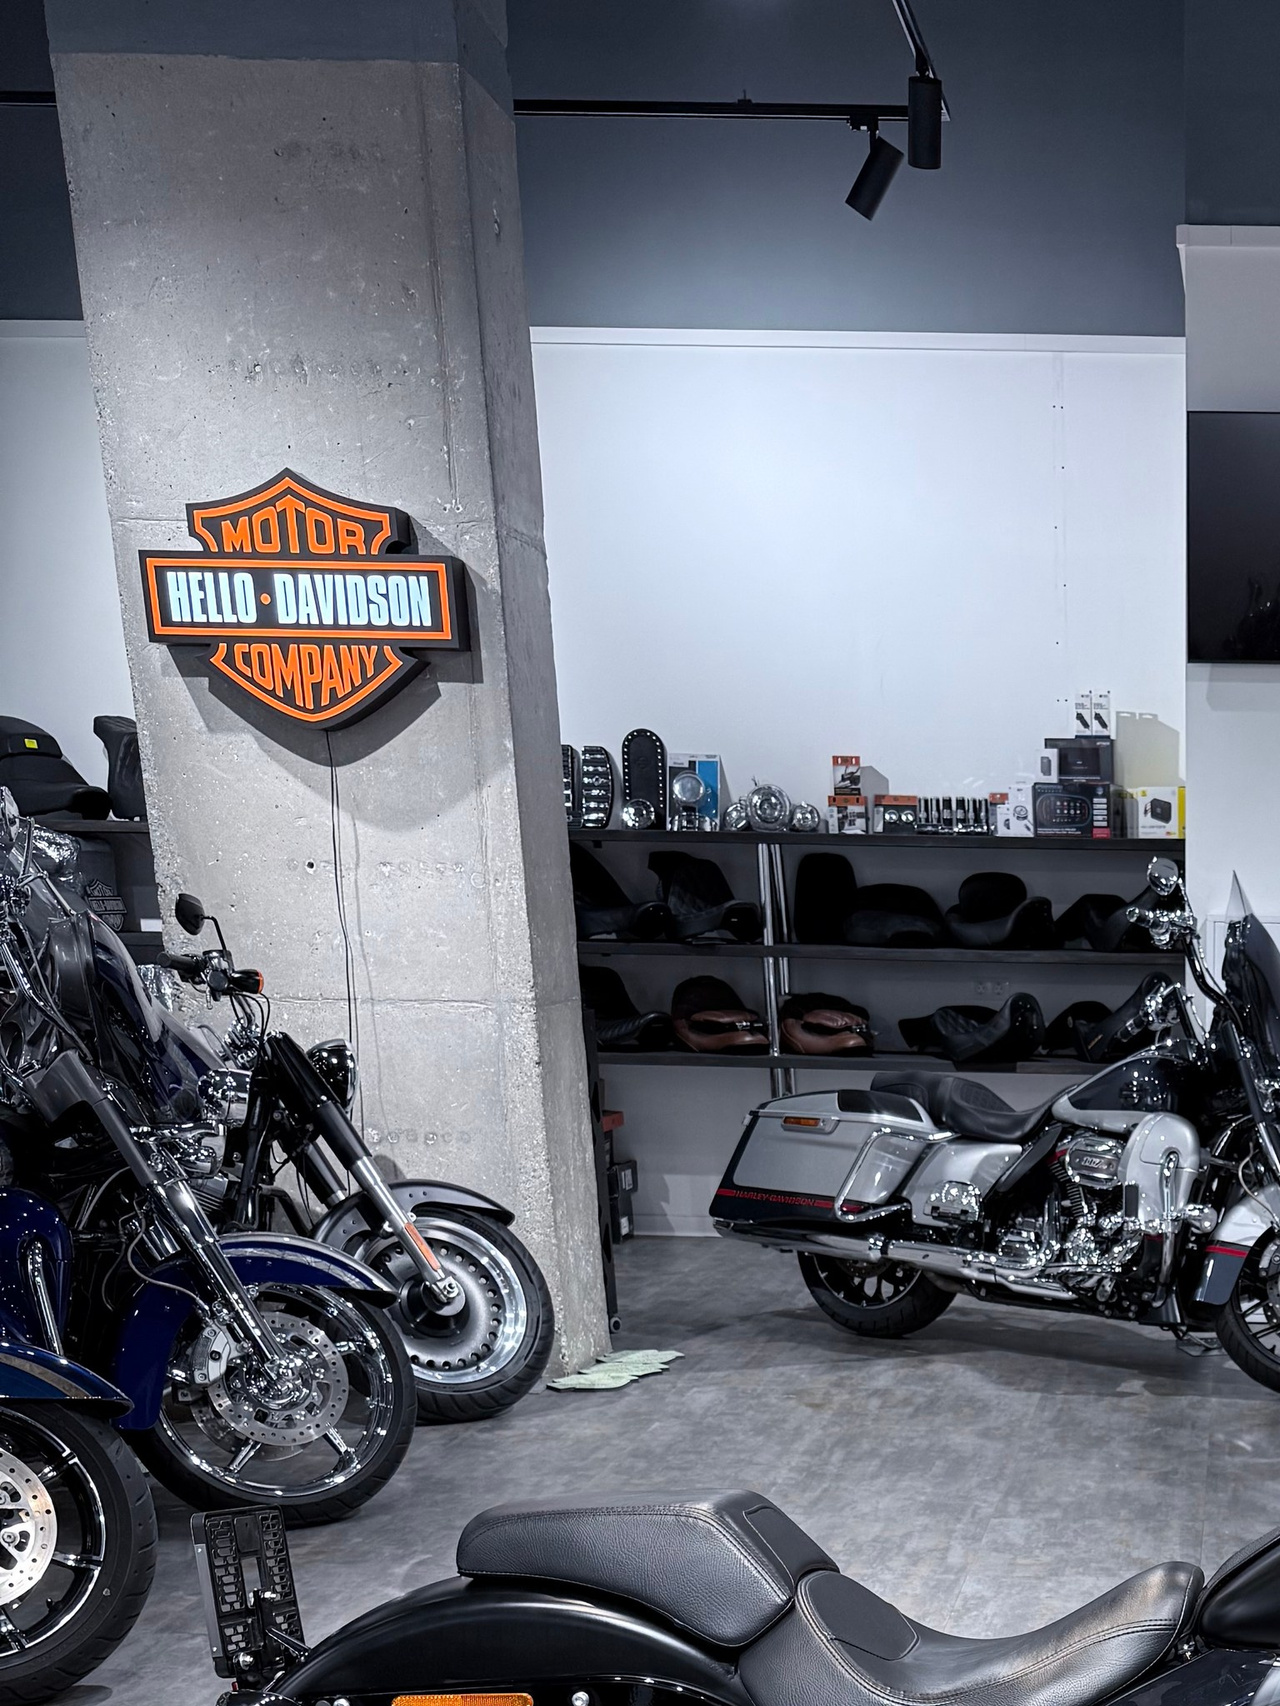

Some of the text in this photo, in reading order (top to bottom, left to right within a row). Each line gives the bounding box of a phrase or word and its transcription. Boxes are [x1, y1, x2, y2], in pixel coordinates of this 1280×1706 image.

[220, 493, 366, 555] MOTOR
[166, 571, 433, 627] HELLO DAVIDSON
[234, 643, 379, 709] COMPANY
